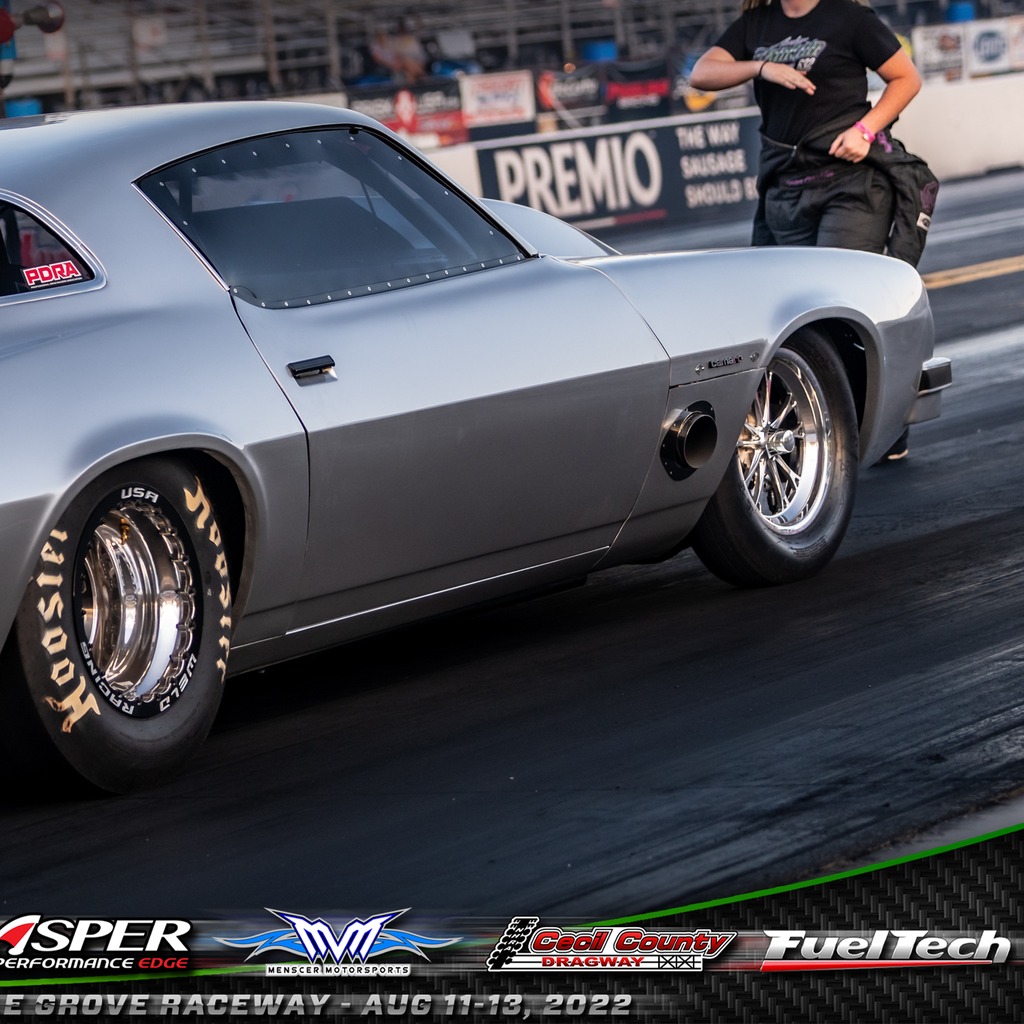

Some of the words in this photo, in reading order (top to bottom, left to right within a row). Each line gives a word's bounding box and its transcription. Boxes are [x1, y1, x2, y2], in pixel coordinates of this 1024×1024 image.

[676, 125, 707, 150] THE
[707, 120, 740, 146] WAY
[493, 130, 663, 217] PREMIO
[680, 149, 747, 179] SAUSAGE
[685, 179, 743, 208] SHOULD
[23, 260, 82, 286] PDRA
[120, 486, 160, 504] USA
[80, 640, 136, 715] RACING
